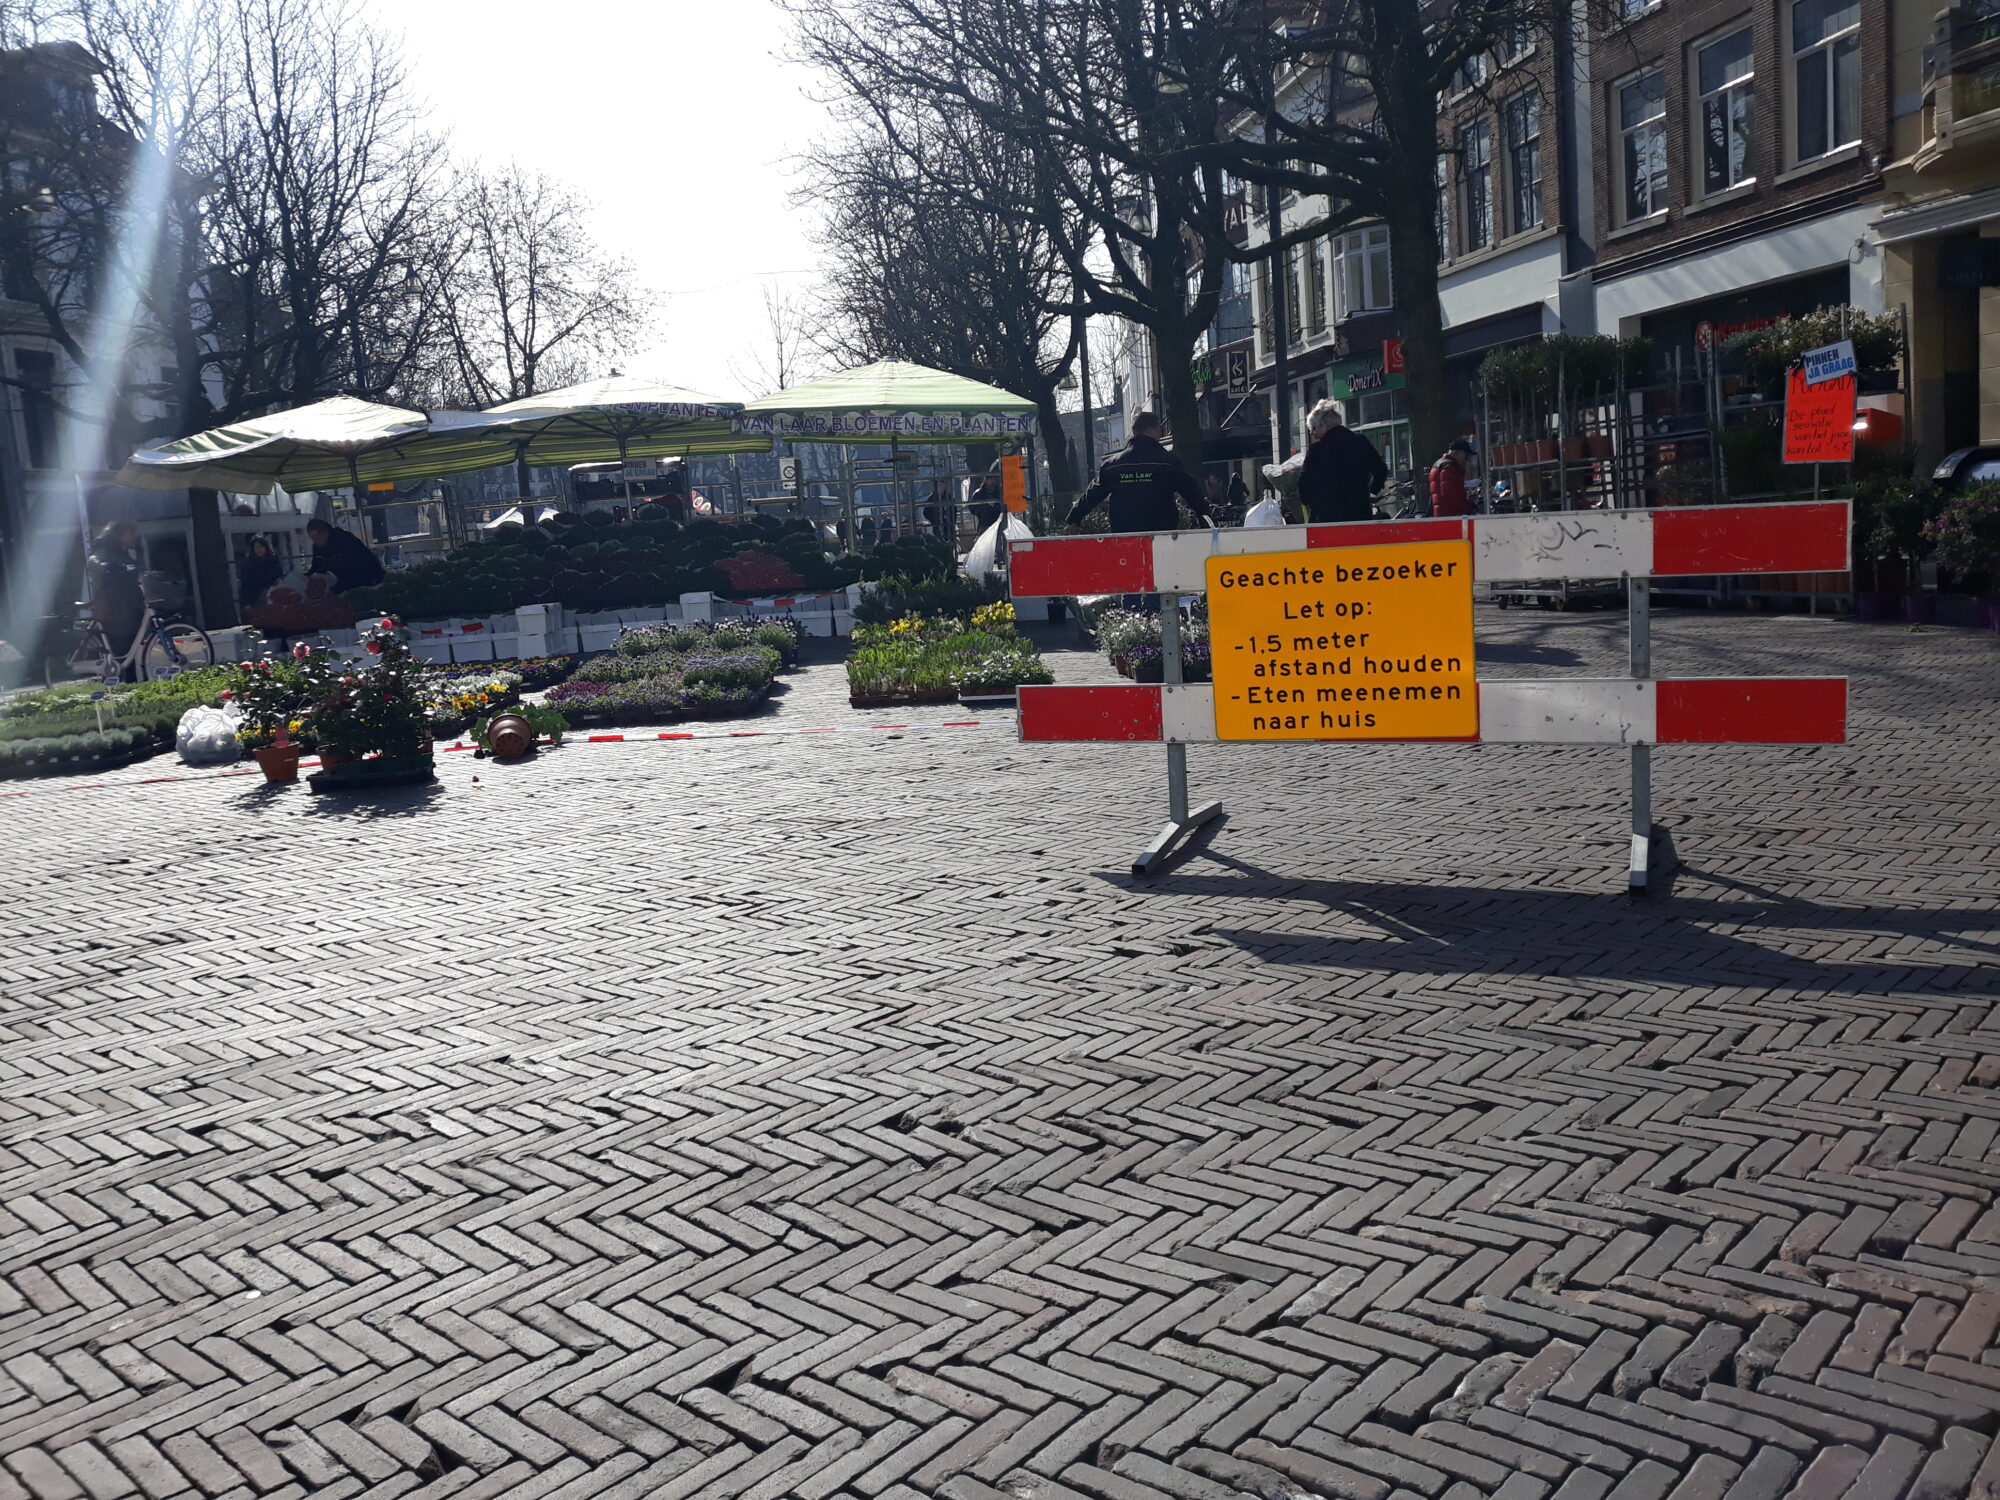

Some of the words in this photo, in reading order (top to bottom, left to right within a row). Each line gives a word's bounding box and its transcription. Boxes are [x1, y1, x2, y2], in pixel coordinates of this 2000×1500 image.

[1805, 348, 1840, 367] PINNEN
[1808, 367, 1821, 379] JA
[1822, 356, 1855, 375] GRAAG
[740, 415, 774, 432] VAN
[780, 416, 826, 432] LAAR
[832, 416, 917, 432] BLOEMEN
[921, 417, 943, 432] EN
[950, 416, 1029, 433] PLANTEN
[1219, 567, 1326, 589] Geachte
[1335, 560, 1458, 583] bezoeker
[1283, 600, 1326, 620] Let
[1335, 600, 1373, 620] op:
[1293, 631, 1371, 651] meter
[1253, 656, 1352, 678] afstand
[1363, 653, 1462, 675] houden
[1316, 684, 1462, 703] meenemen
[1252, 714, 1311, 731] naar
[1320, 710, 1377, 728] huis
